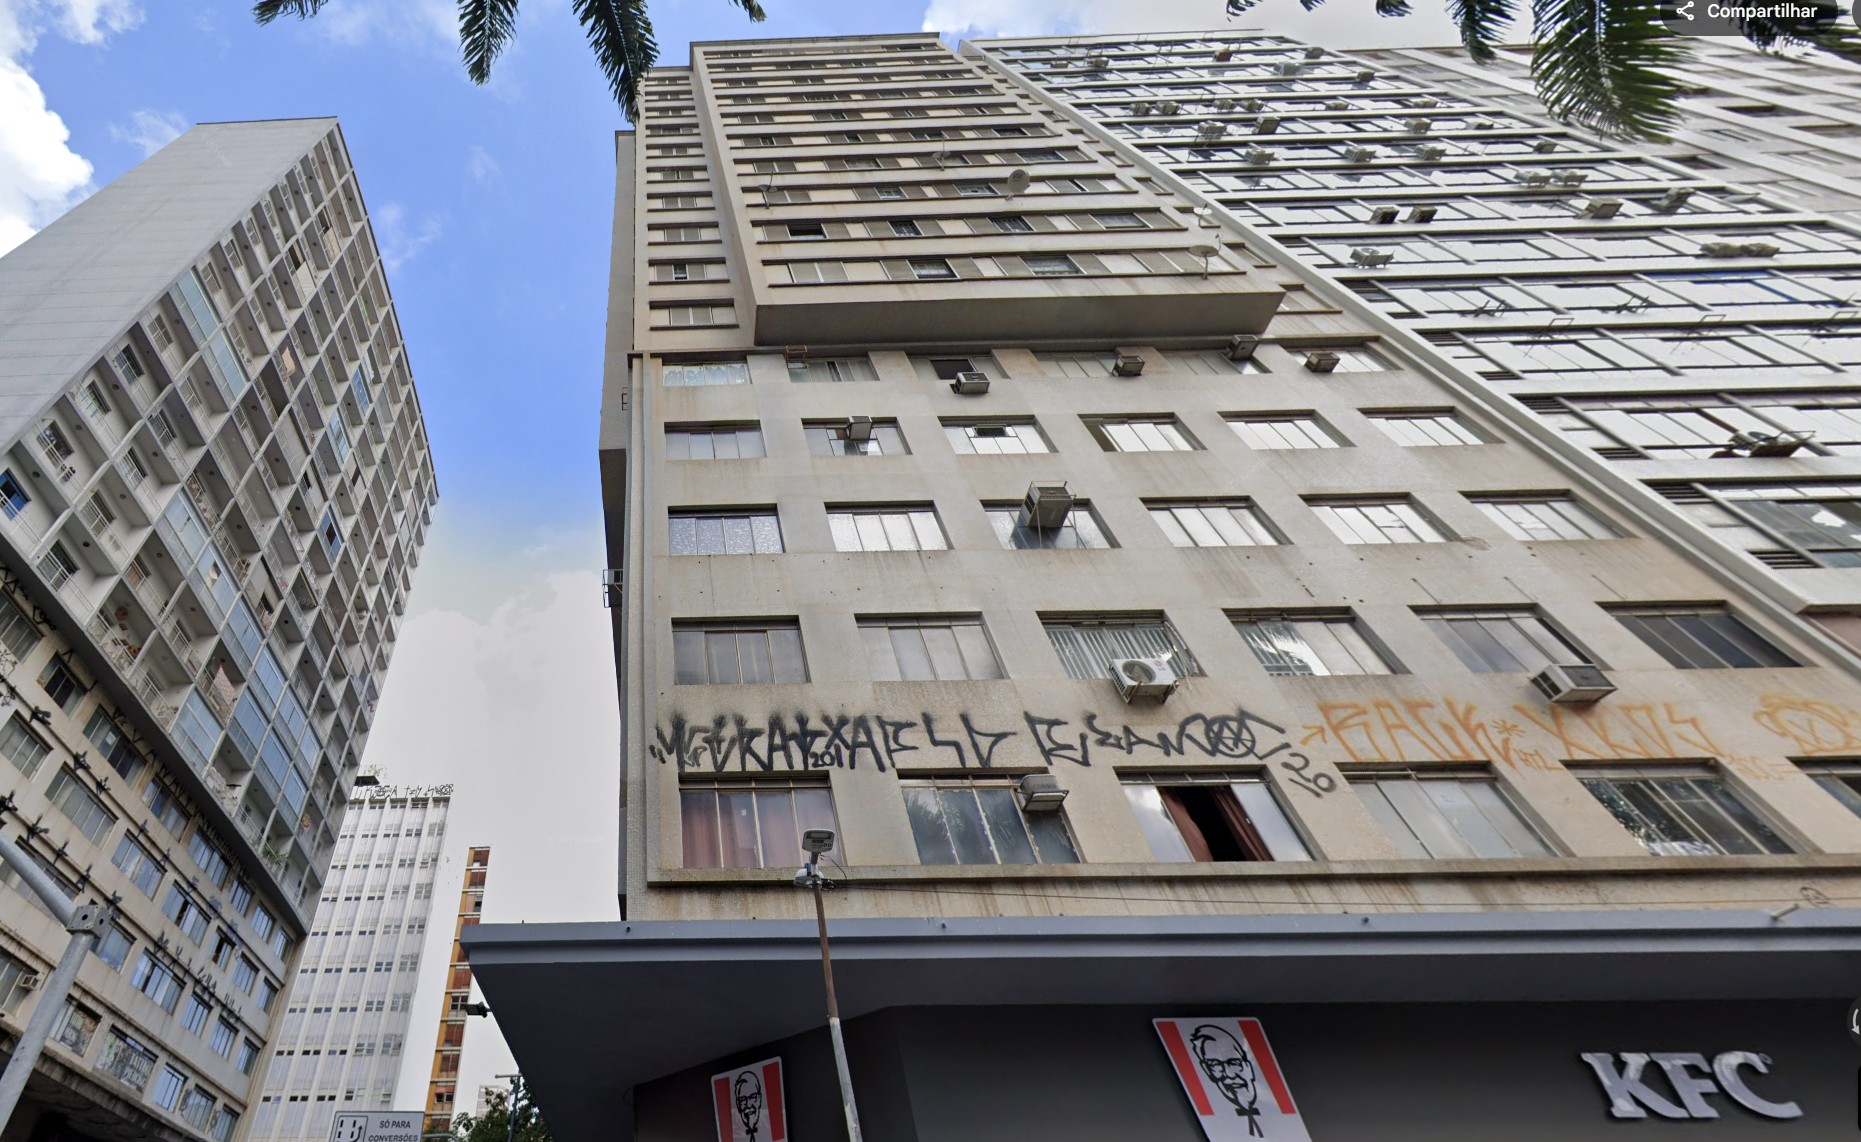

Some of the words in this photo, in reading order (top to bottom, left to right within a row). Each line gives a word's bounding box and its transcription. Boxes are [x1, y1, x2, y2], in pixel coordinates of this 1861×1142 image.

[1580, 1051, 1804, 1118] KFC
[380, 1118, 391, 1129] SÓ
[391, 1120, 412, 1129] PARA
[369, 1133, 418, 1142] CONVERSÕES
